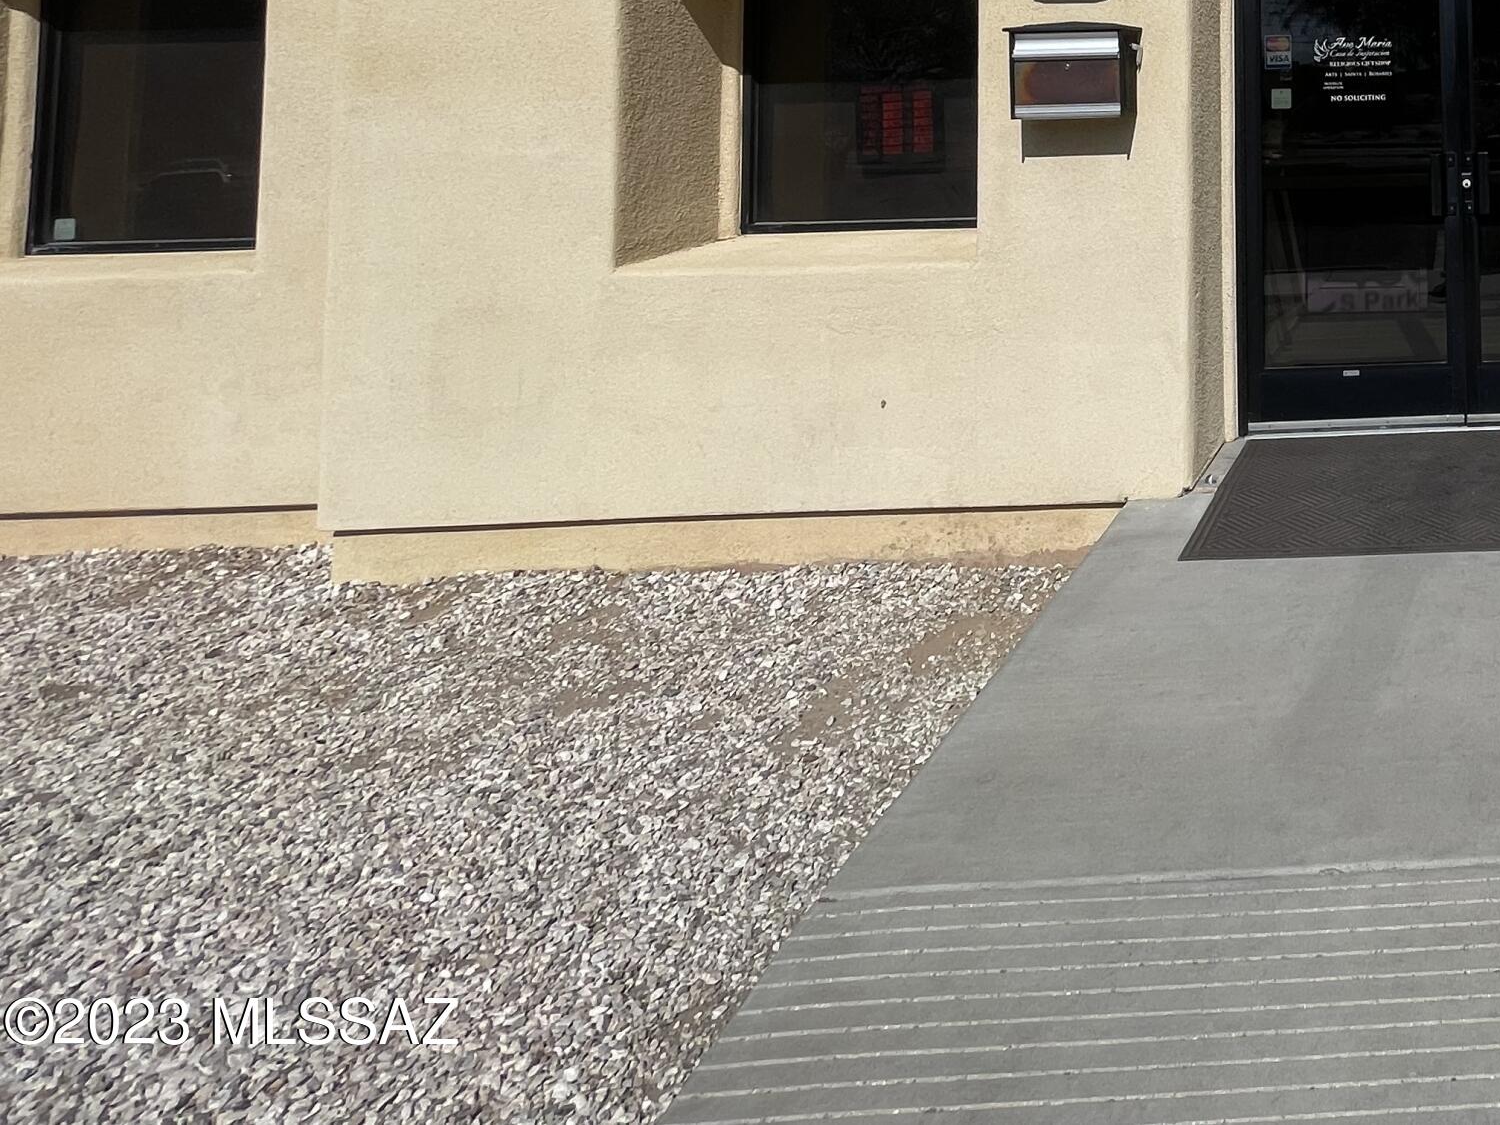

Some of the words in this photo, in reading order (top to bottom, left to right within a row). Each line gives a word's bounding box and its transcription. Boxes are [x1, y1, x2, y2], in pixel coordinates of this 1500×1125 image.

[1355, 35, 1393, 49] Maria
[1269, 54, 1290, 63] VISA
[1343, 94, 1386, 102] SOLICITING
